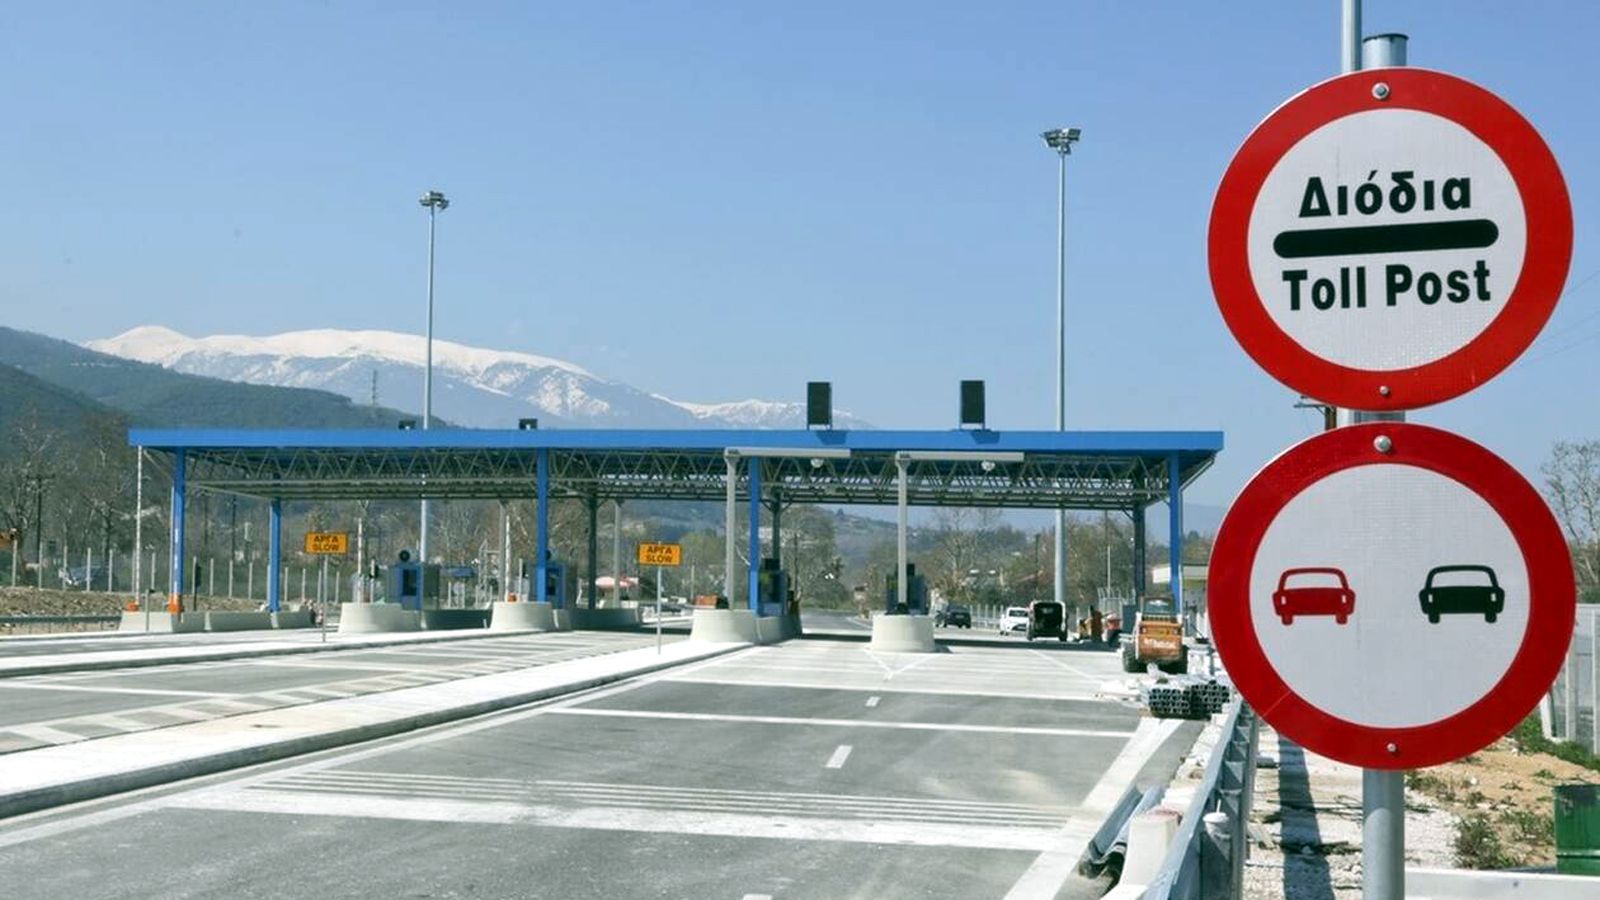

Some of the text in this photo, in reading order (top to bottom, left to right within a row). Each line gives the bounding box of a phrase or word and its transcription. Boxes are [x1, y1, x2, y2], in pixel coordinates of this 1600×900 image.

[1299, 170, 1471, 218] Διόδια
[1282, 260, 1491, 311] Toll Post
[311, 543, 340, 551] SLOW
[646, 555, 673, 563] SLOW
